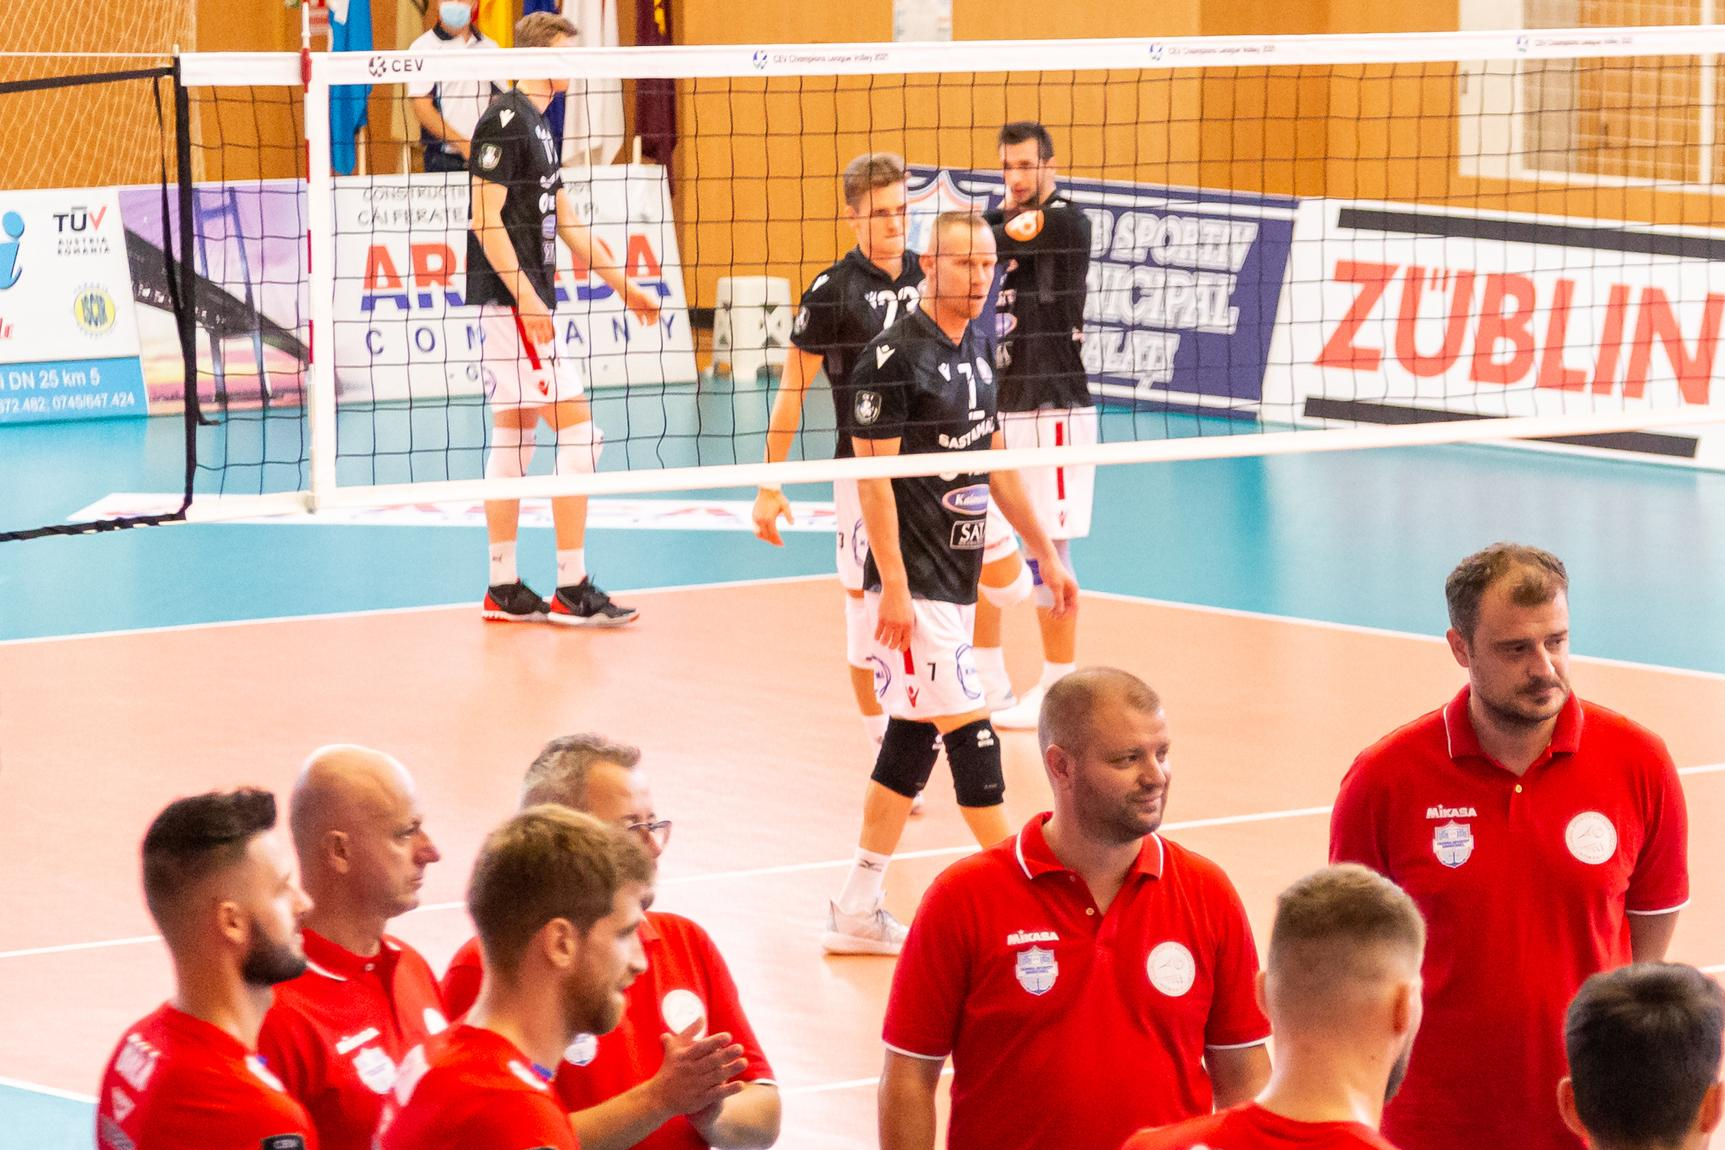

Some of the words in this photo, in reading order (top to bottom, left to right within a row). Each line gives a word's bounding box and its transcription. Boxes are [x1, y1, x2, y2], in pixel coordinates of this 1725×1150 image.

[391, 58, 424, 73] CEV
[9, 371, 35, 391] DN
[62, 368, 87, 387] km
